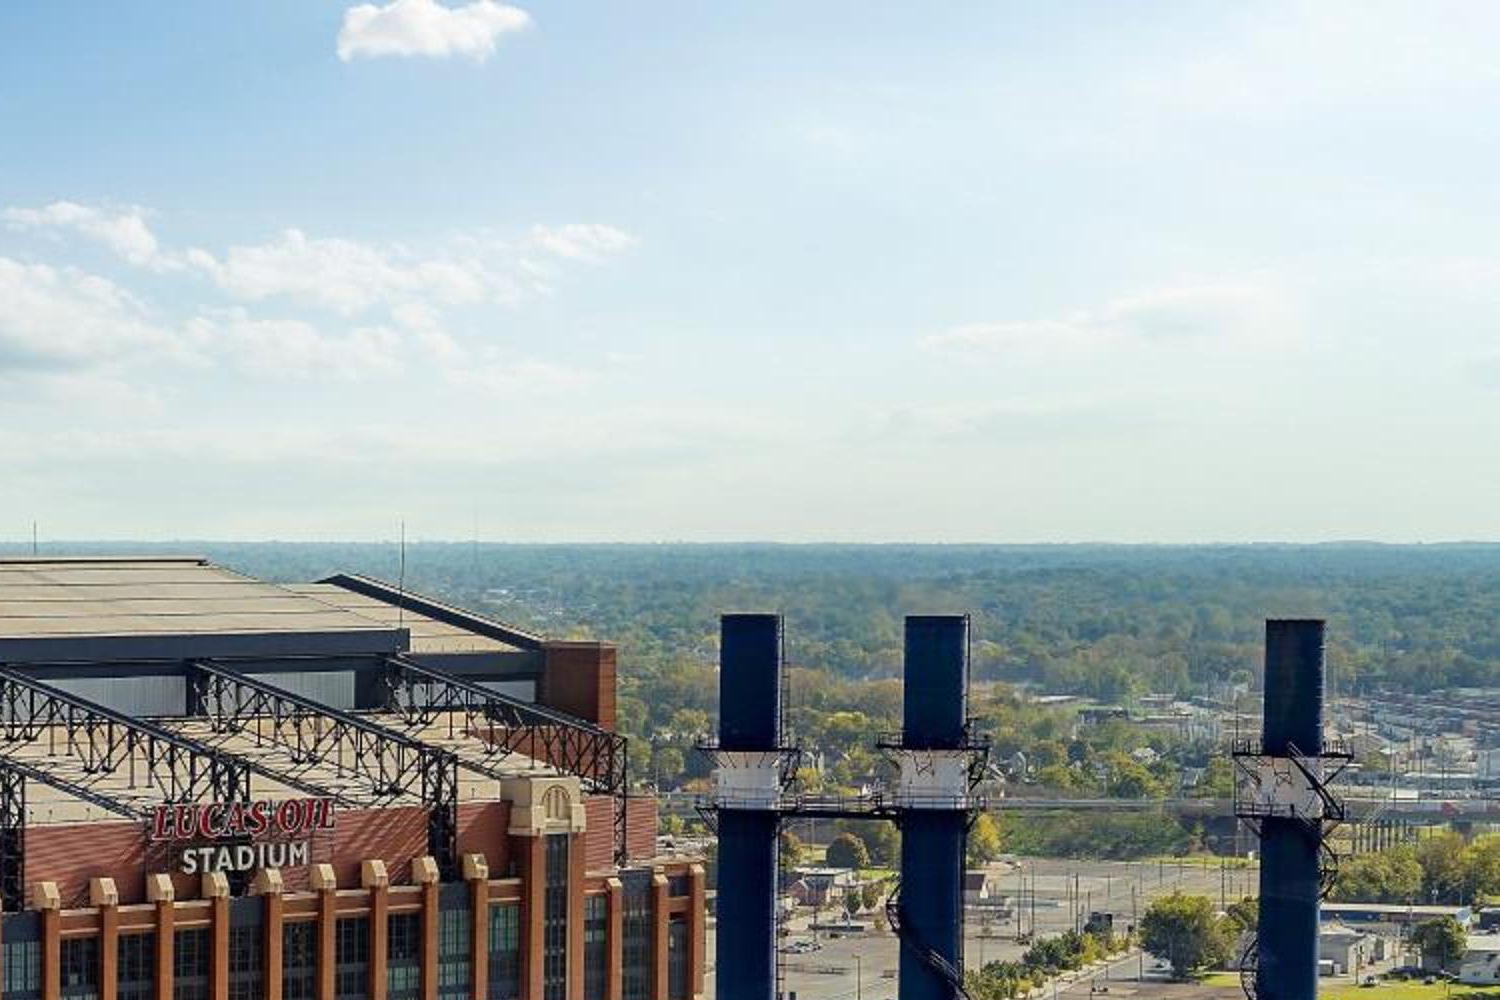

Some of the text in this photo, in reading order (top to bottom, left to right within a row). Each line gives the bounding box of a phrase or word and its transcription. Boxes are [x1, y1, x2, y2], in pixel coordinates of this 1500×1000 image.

[152, 796, 337, 841] LUCAS OIL
[182, 841, 309, 874] STADIUM
